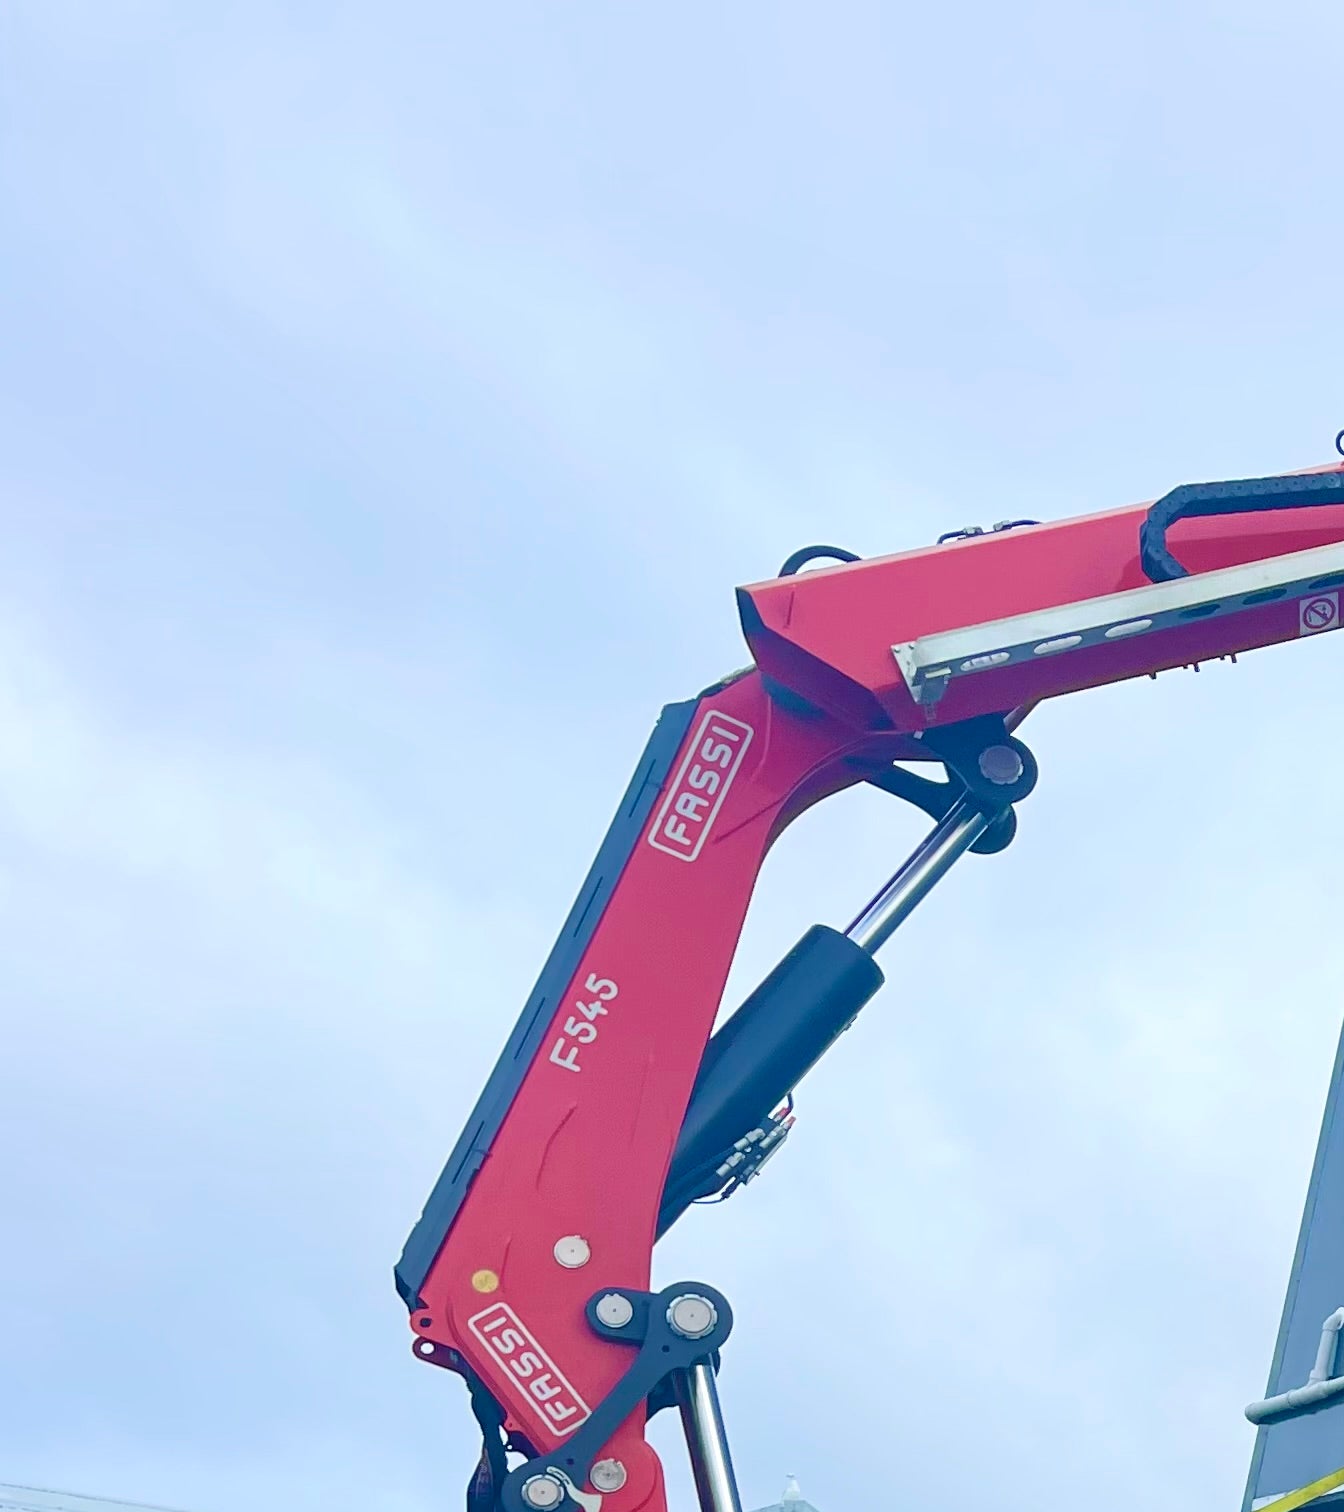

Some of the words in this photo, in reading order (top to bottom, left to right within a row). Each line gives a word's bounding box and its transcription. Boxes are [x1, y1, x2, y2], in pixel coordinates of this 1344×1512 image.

[664, 725, 740, 844] FASSI
[549, 973, 619, 1073] F545
[483, 1316, 577, 1421] FASSI
